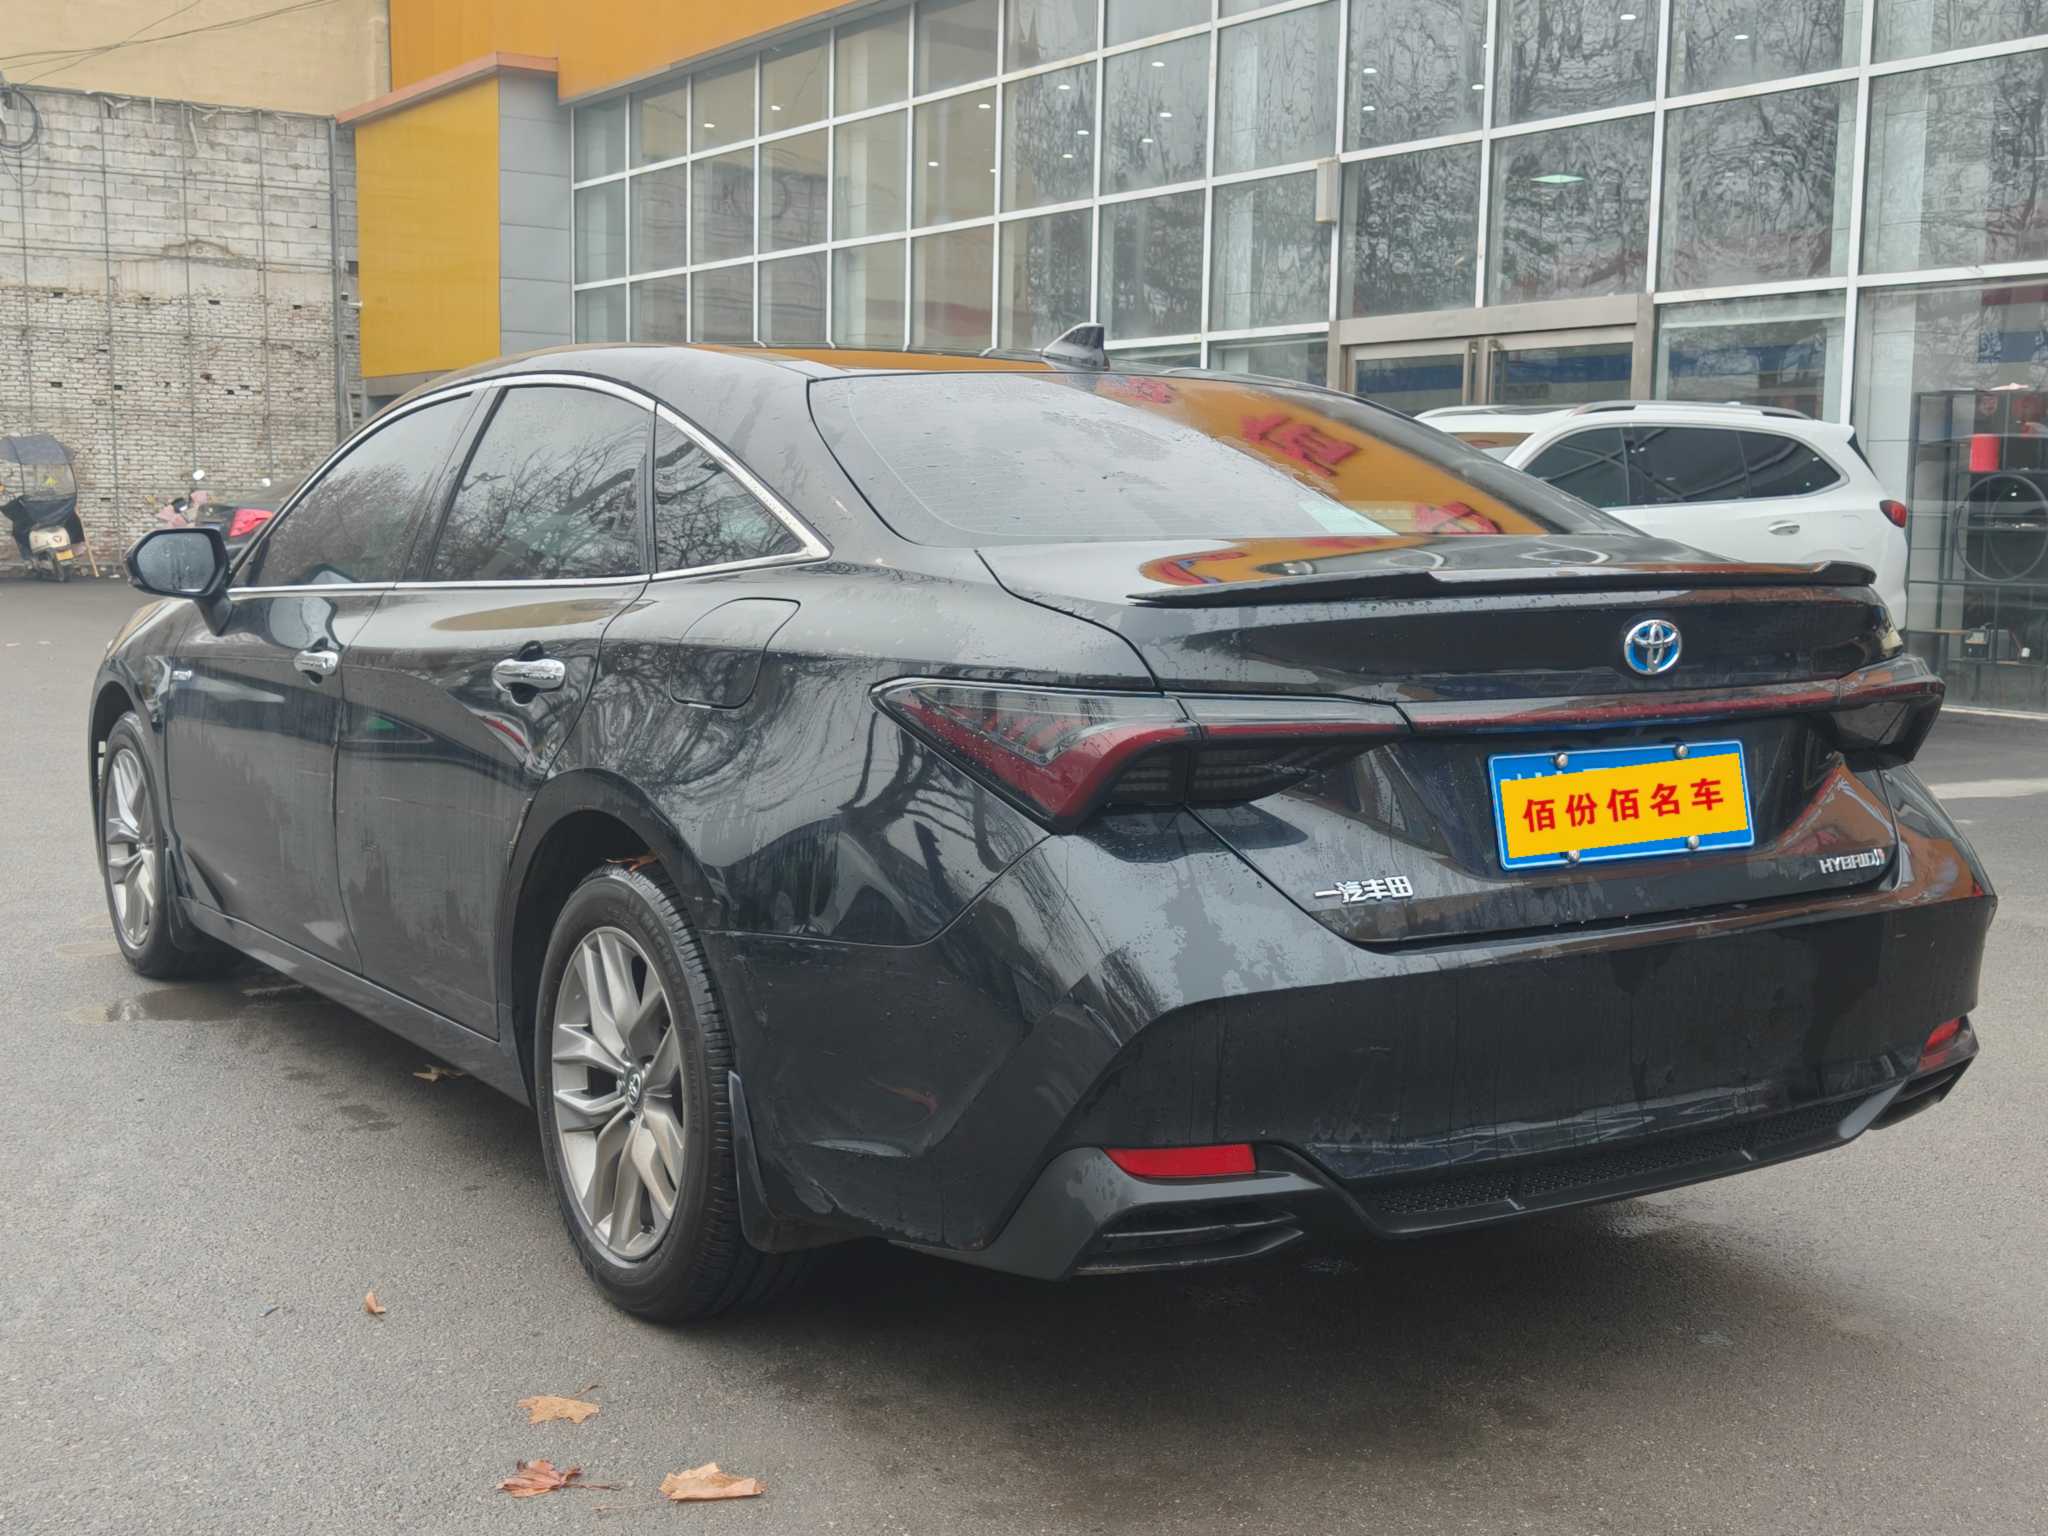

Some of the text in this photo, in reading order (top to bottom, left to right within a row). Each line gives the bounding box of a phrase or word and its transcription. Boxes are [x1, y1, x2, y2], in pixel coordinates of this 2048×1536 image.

[1819, 852, 1877, 874] HYBRID
[1314, 876, 1413, 904] 一汽丰田
